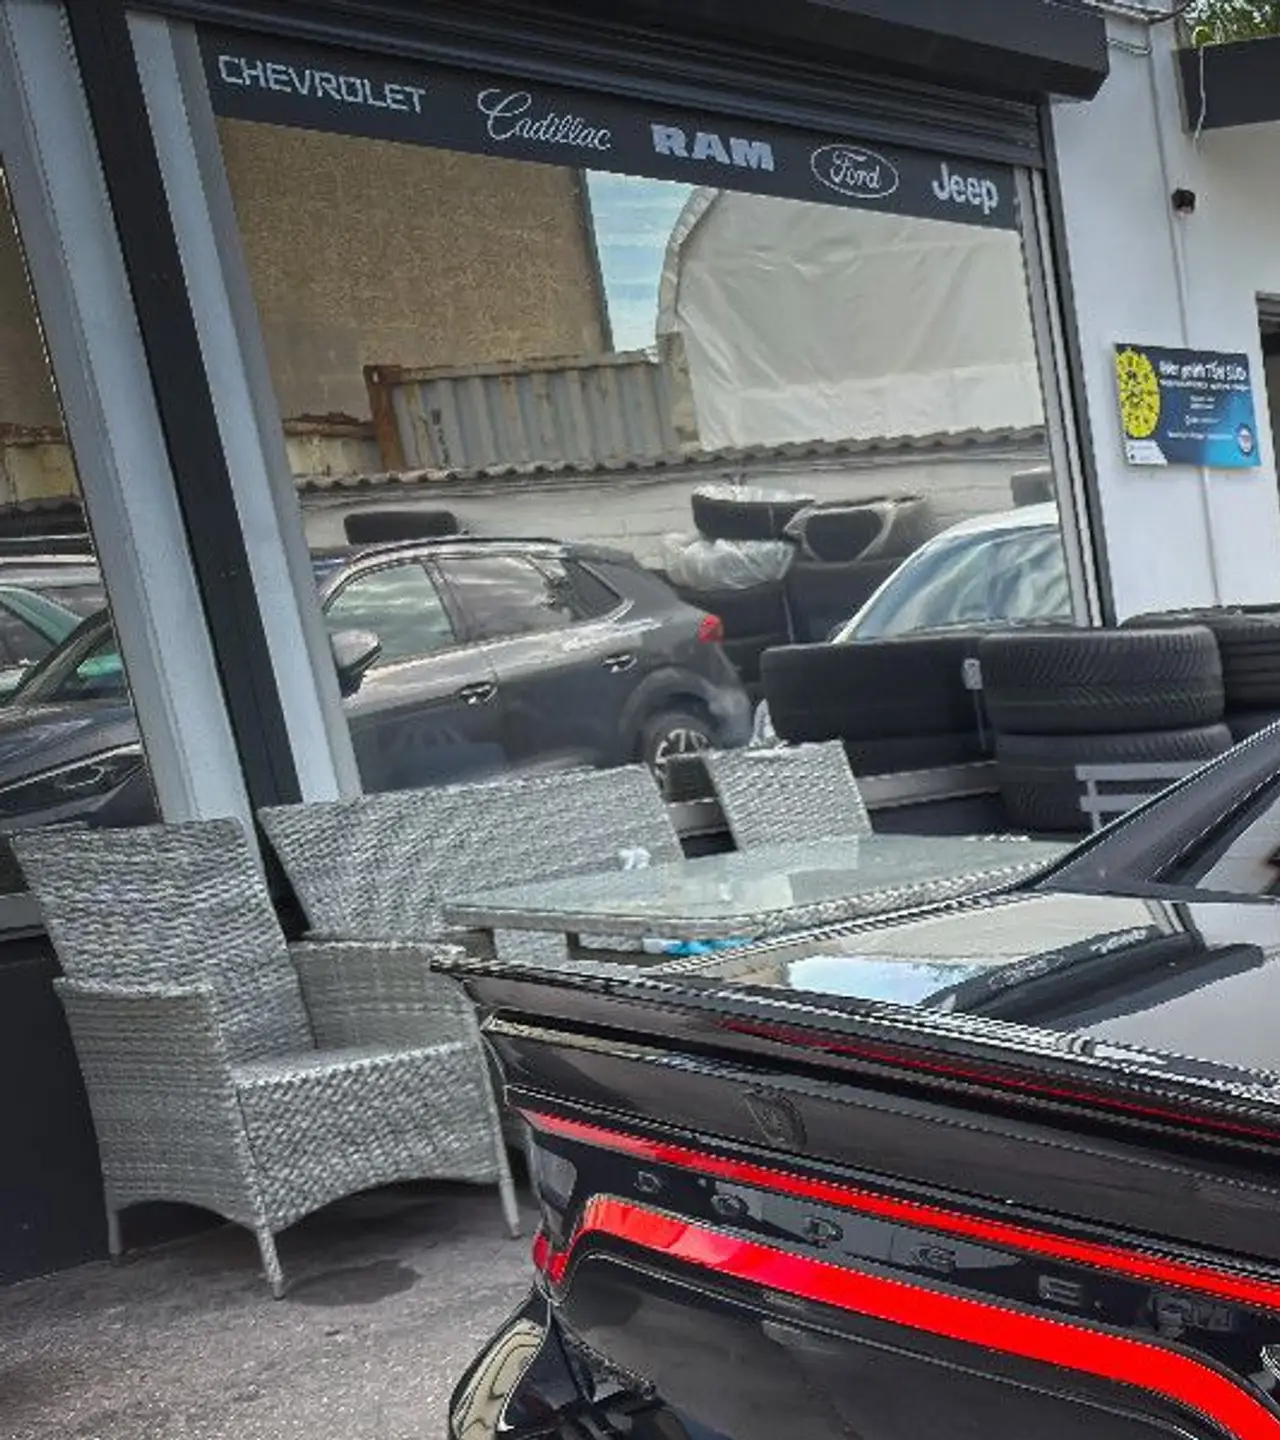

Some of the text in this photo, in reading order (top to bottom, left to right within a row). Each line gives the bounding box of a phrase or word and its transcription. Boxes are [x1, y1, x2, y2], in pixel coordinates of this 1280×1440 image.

[217, 54, 999, 215] CHEVROLET Cadillac RAM Ford Jeep
